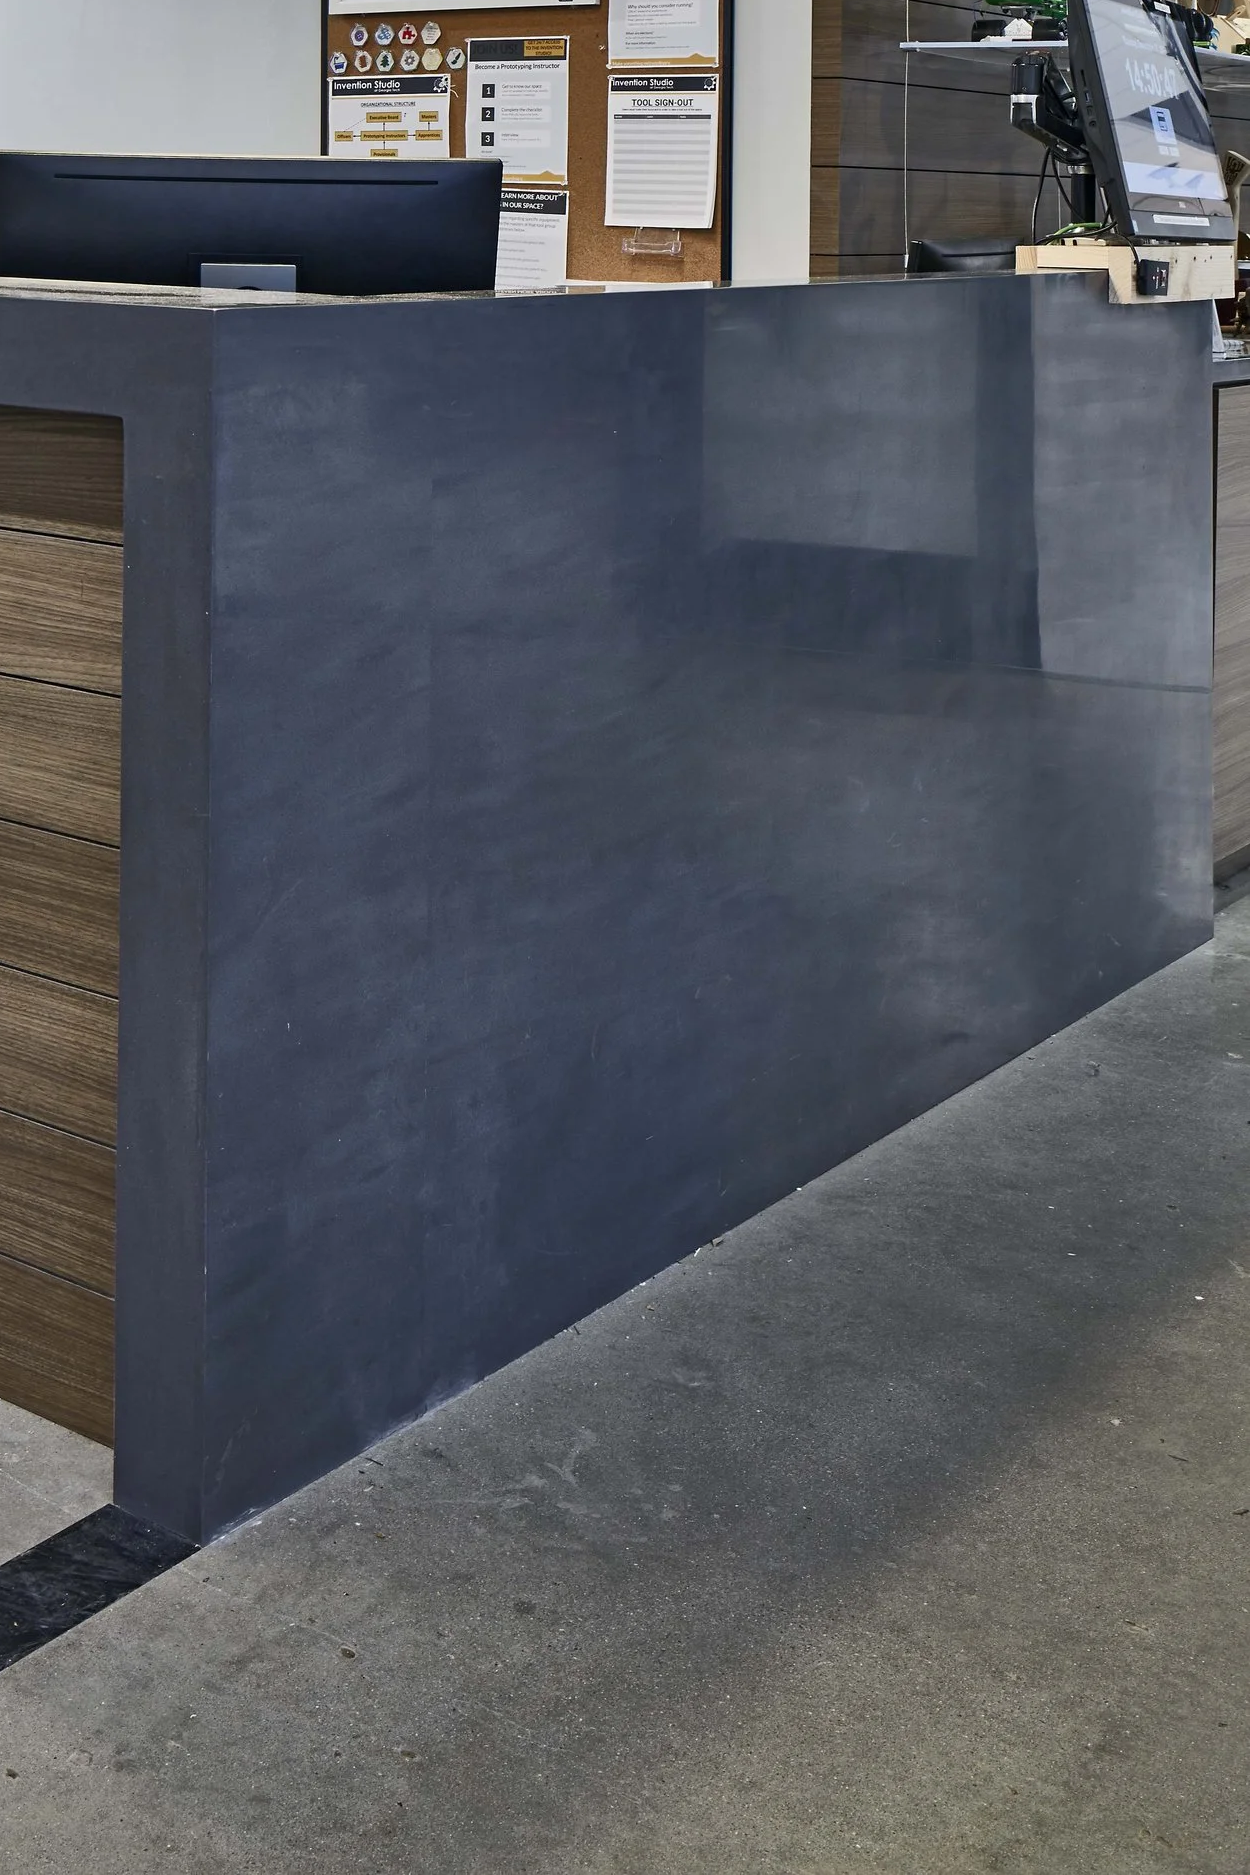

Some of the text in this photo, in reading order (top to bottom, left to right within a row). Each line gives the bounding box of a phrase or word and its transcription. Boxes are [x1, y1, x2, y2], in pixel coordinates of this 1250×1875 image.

[334, 80, 400, 90] Invention Studio
[650, 78, 674, 86] Studio
